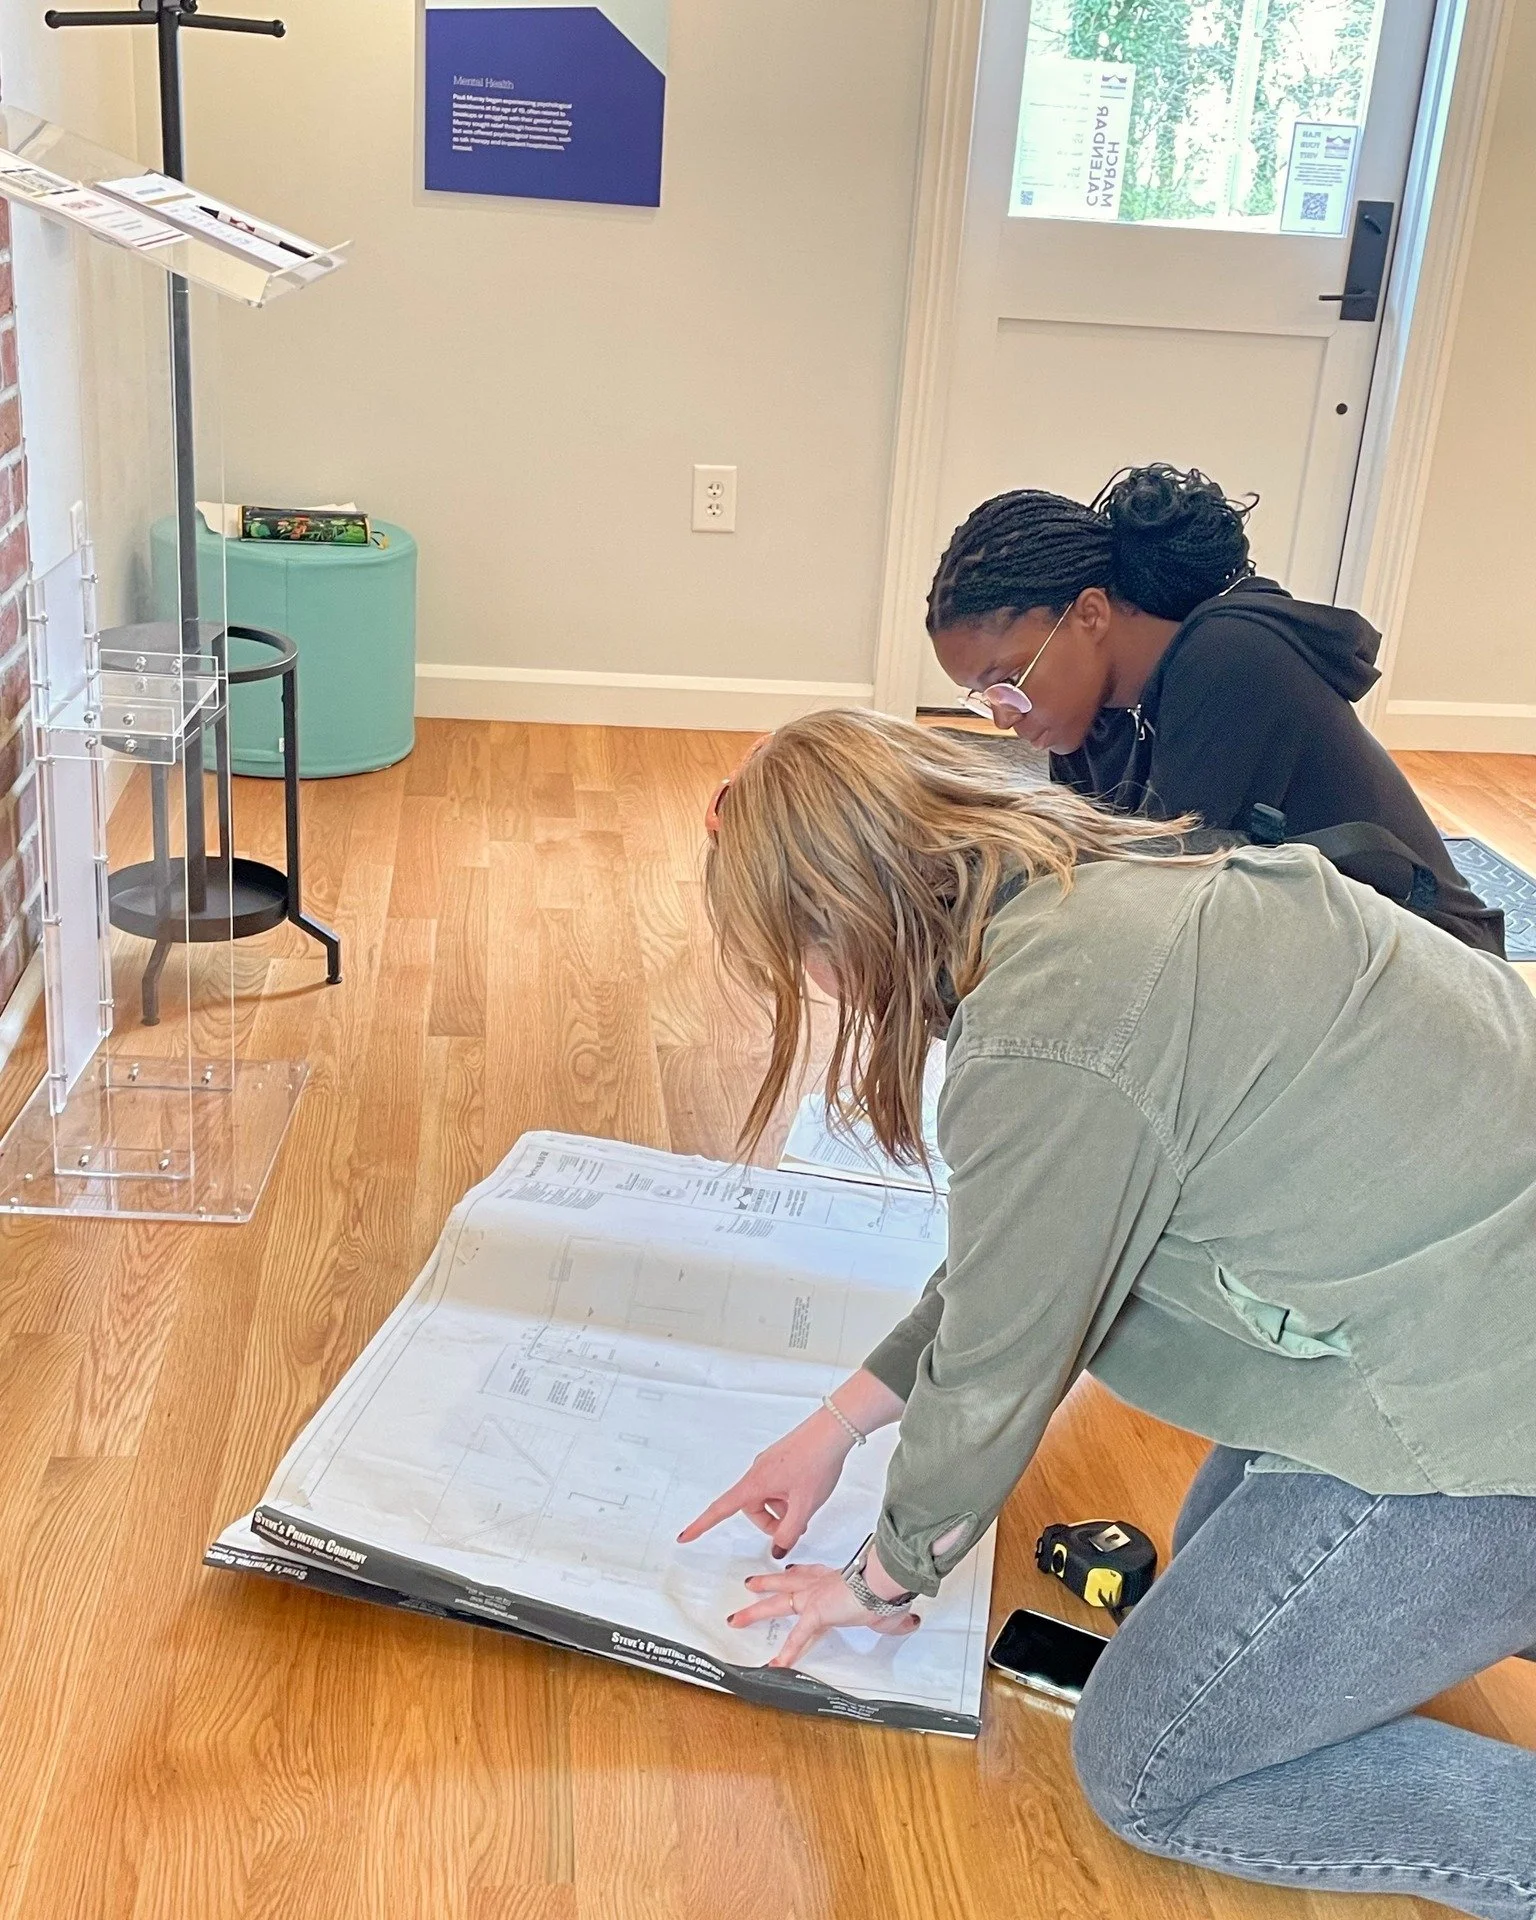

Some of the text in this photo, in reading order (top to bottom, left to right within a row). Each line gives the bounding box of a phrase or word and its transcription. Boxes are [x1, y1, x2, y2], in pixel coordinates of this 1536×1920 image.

[454, 75, 514, 89] Mental Health
[467, 95, 485, 103] Murray
[453, 119, 471, 127] Murray
[254, 1511, 368, 1564] STEVE'S PRINTING COMPANY
[611, 1631, 646, 1651] STEVE'S
